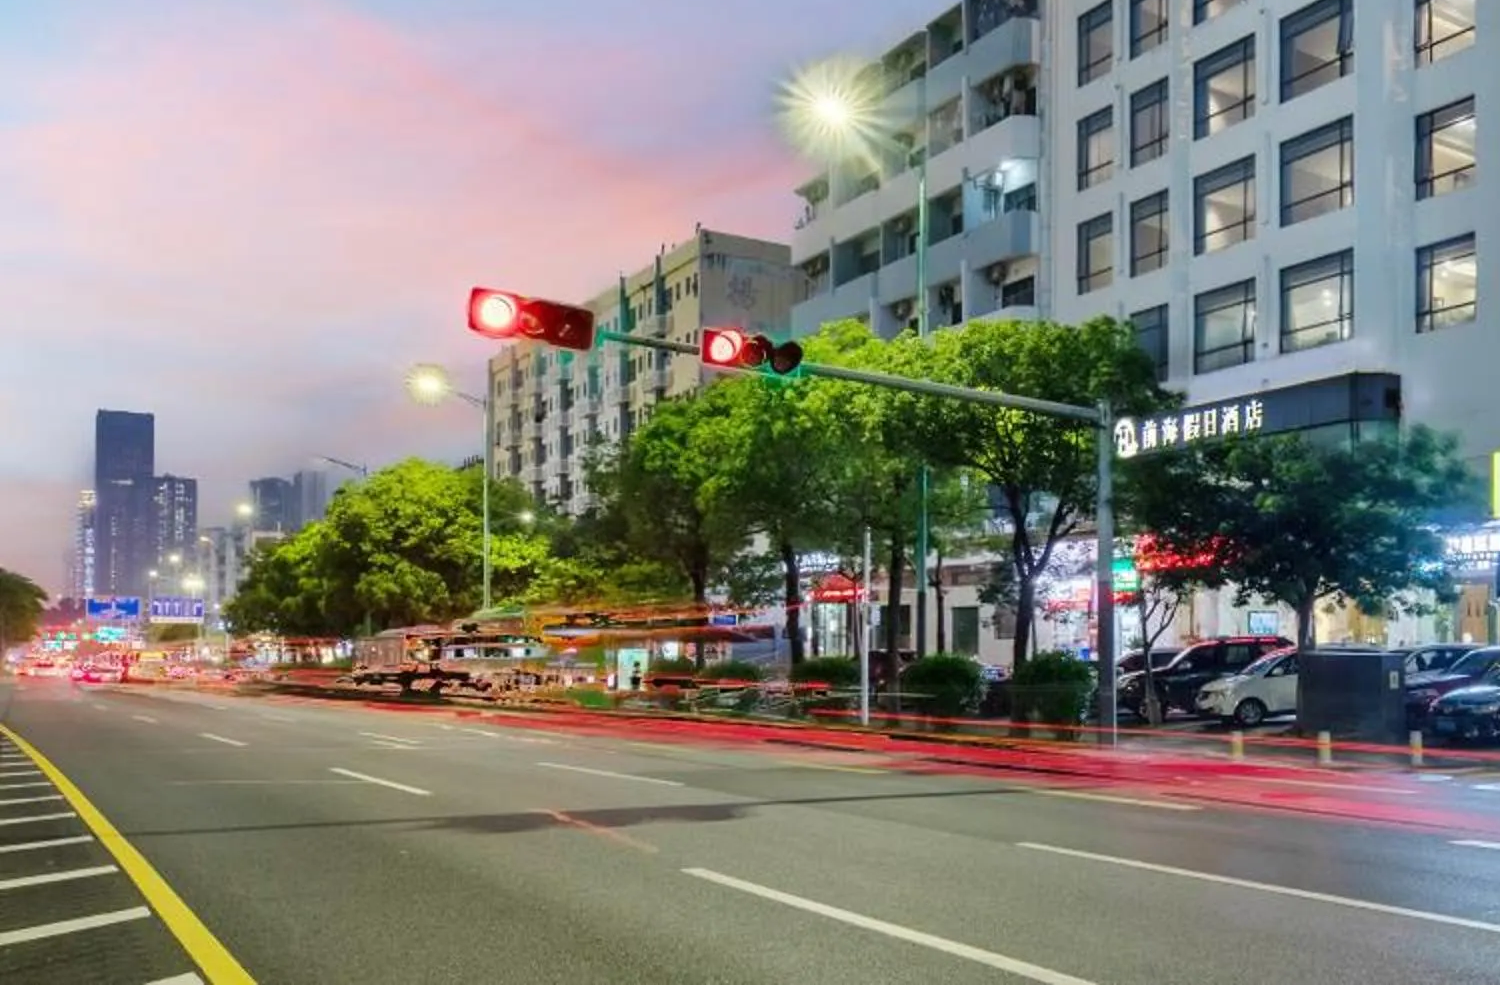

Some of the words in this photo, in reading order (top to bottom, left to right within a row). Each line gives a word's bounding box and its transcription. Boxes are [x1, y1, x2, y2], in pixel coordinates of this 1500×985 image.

[1141, 400, 1264, 450] 前海假日酒店
